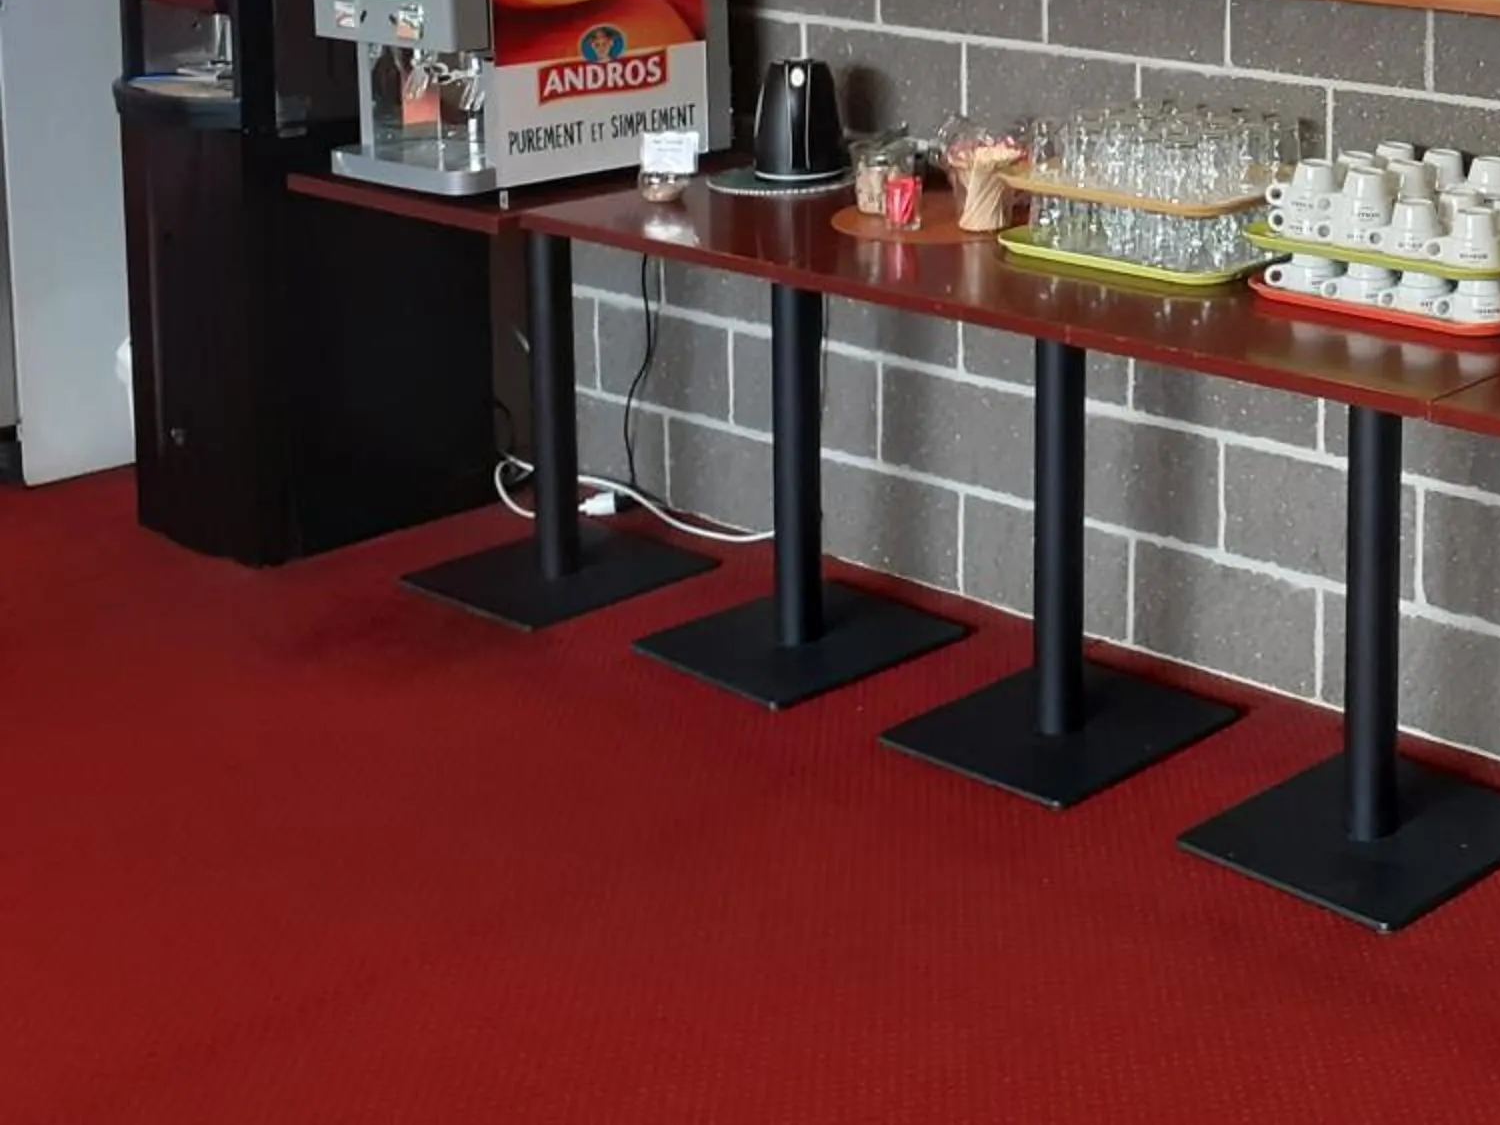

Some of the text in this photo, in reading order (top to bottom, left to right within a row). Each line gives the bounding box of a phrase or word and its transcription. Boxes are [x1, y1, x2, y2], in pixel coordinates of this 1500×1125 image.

[542, 55, 662, 97] ANDROS
[508, 104, 696, 156] PUREMENT ET SIMPLEMENT
